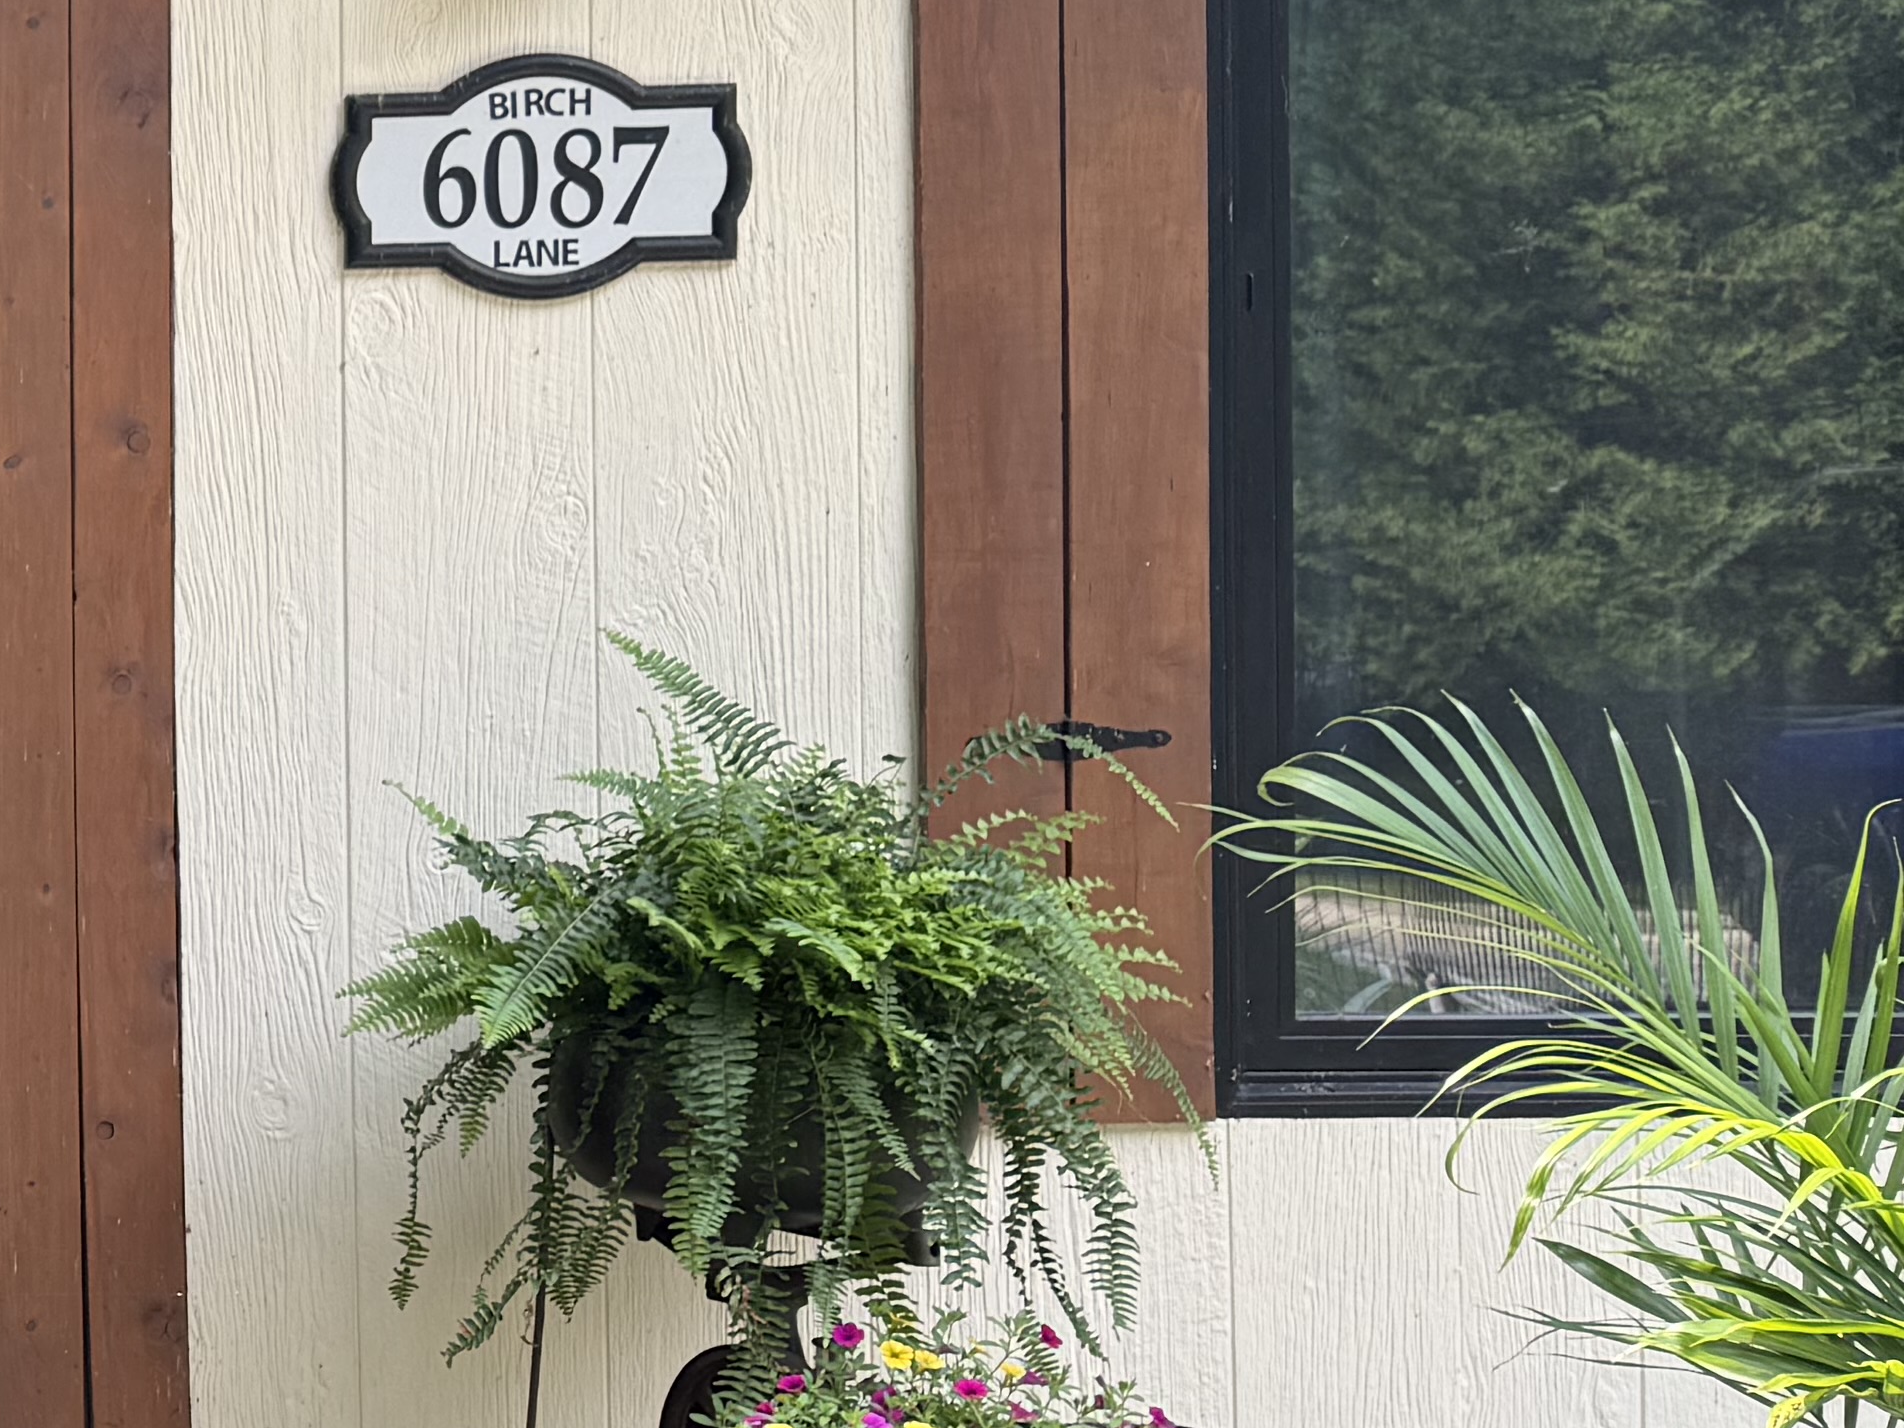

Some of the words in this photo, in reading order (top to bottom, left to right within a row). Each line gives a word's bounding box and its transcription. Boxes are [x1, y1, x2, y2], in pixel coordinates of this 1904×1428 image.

[489, 87, 592, 119] BIRCH
[423, 125, 670, 229] 6087
[492, 238, 580, 268] LANE
